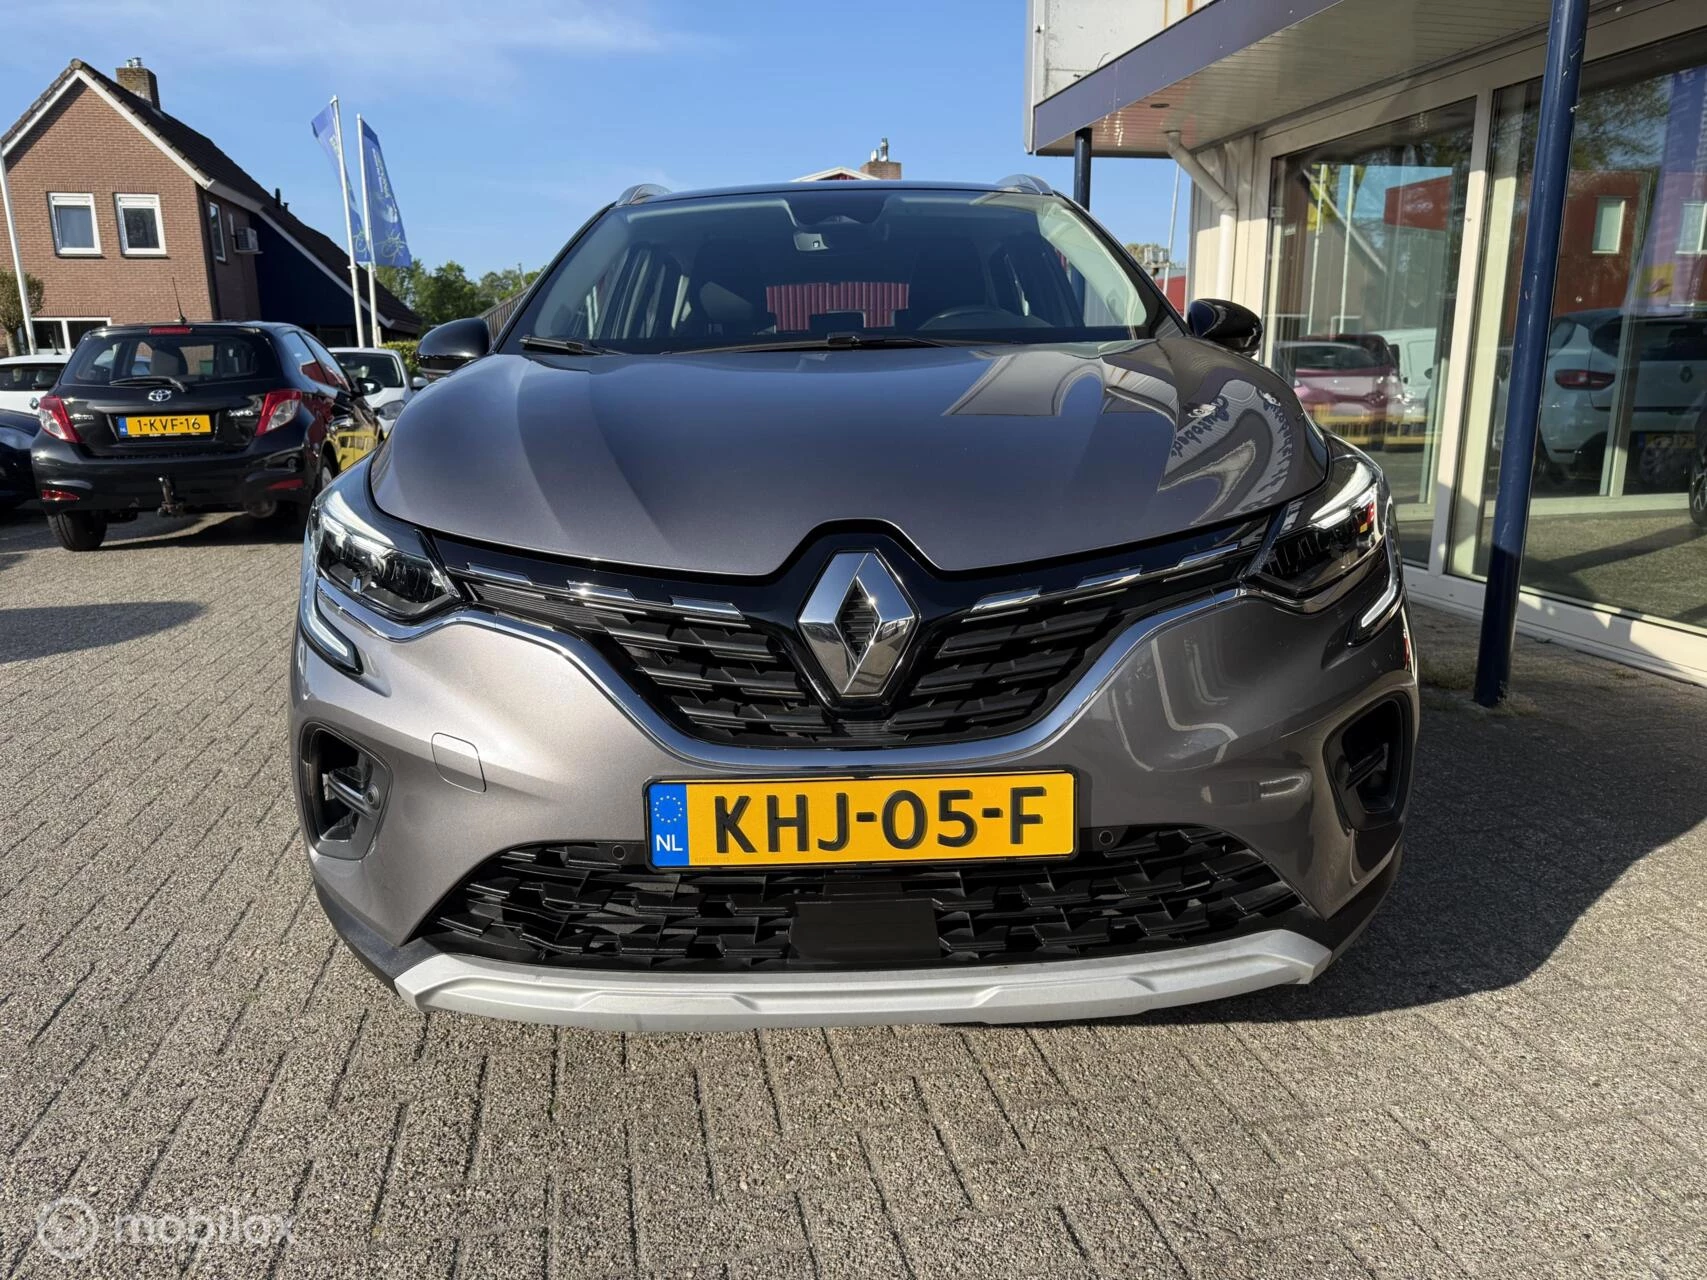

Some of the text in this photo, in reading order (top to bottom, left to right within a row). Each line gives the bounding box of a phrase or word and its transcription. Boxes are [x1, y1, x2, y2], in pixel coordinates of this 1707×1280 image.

[136, 417, 201, 432] 1-KVF-16
[656, 786, 1047, 853] NL KHJ-05-F
